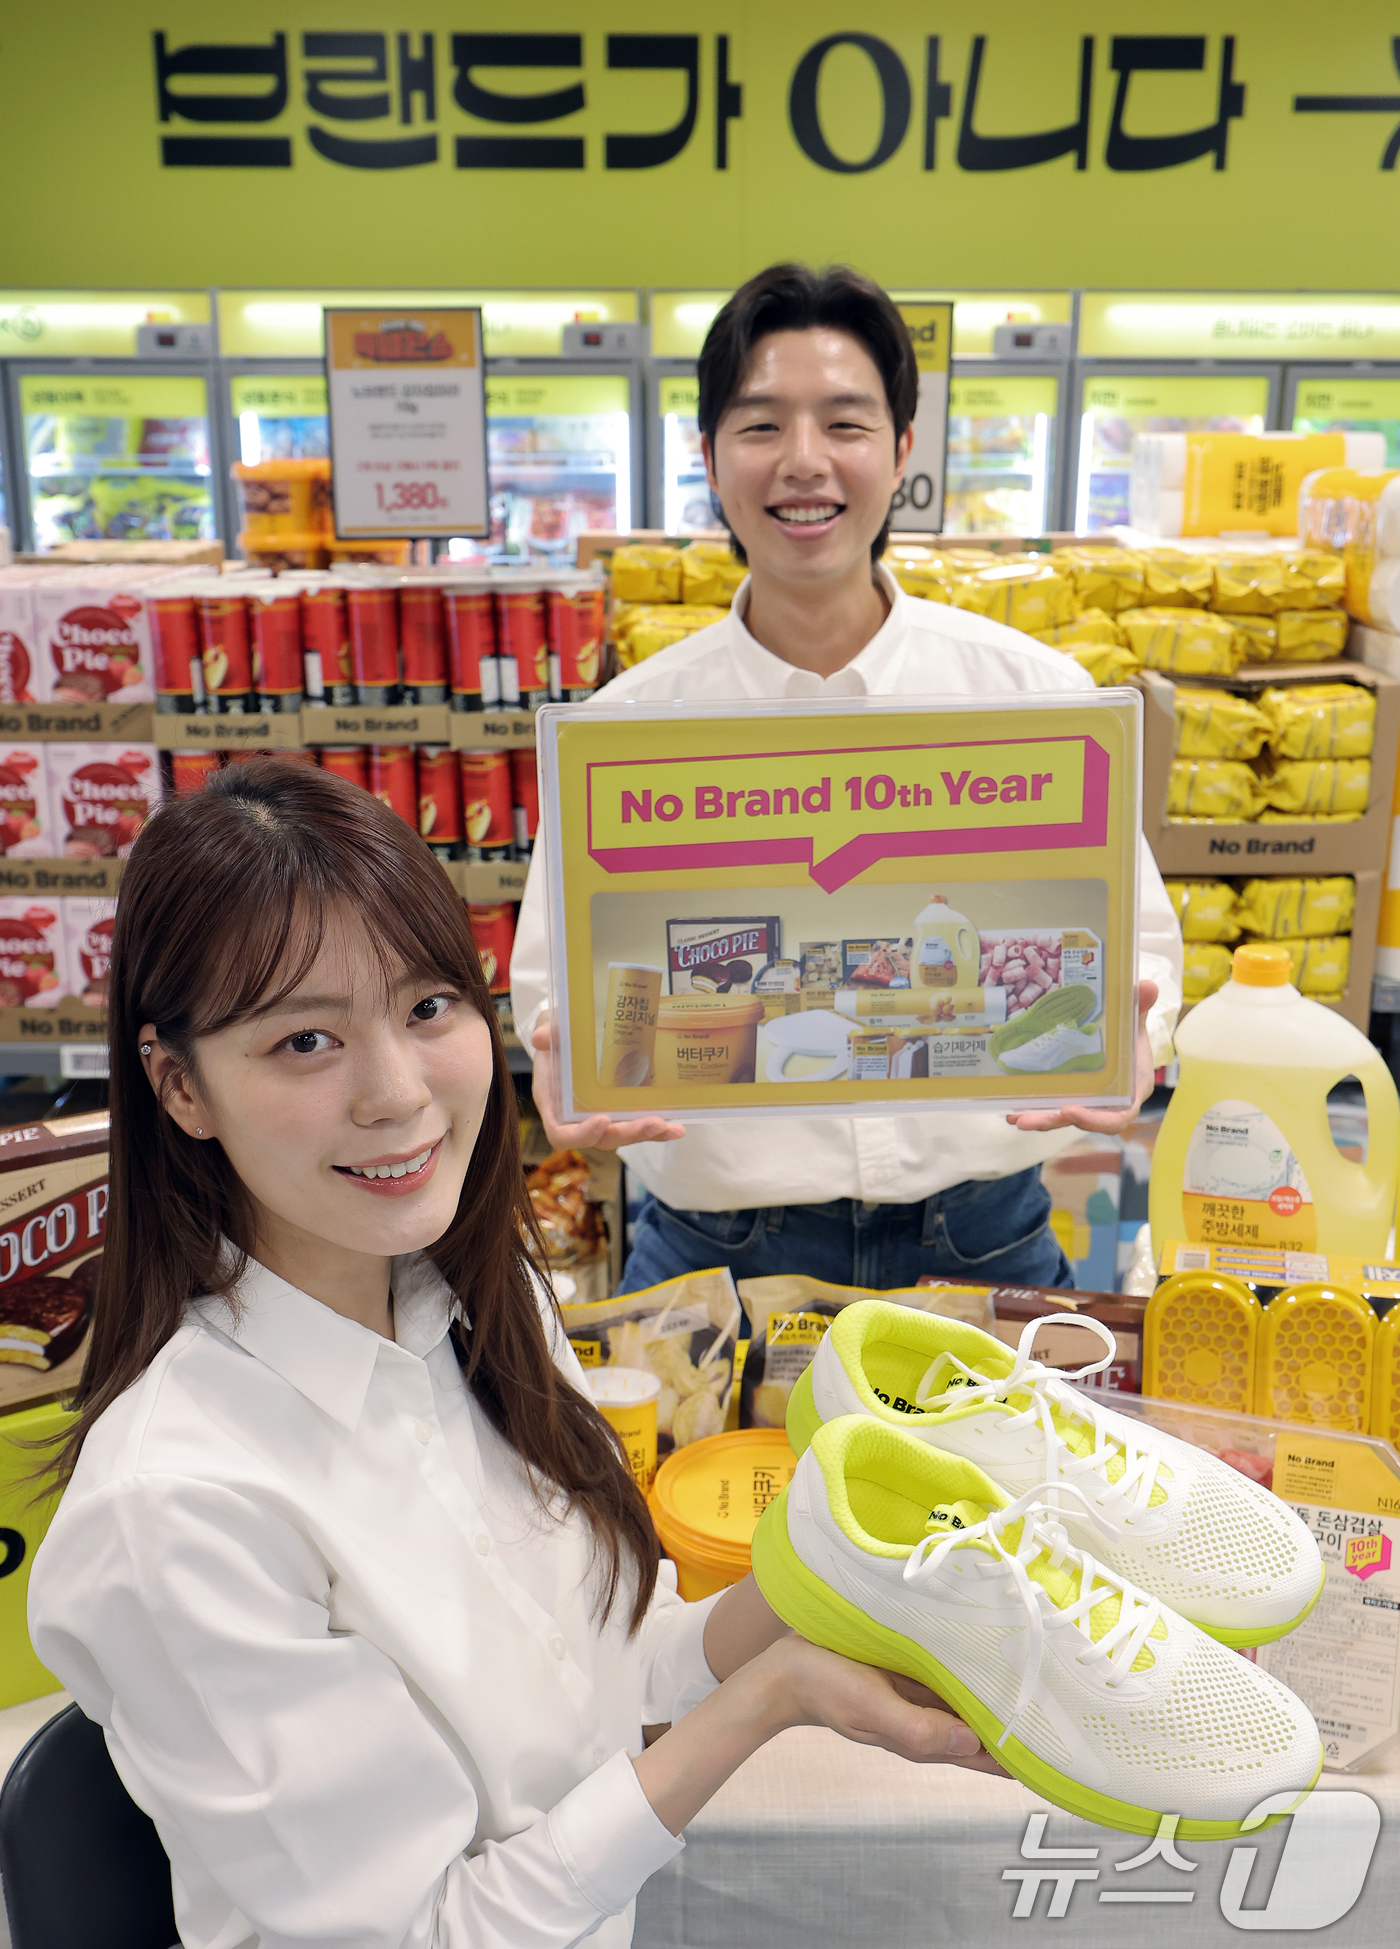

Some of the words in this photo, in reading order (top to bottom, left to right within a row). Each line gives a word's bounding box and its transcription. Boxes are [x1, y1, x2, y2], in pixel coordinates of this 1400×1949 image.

[152, 29, 744, 170] 브랜드가
[788, 31, 1246, 174] 아니다
[51, 620, 138, 648] Choco
[62, 647, 110, 673] Pie
[28, 714, 101, 732] Brand
[187, 723, 210, 737] No
[215, 722, 270, 737] Brand
[336, 718, 360, 731] No
[366, 717, 418, 731] Brand
[484, 723, 508, 736] No
[63, 777, 143, 802] Choco
[621, 790, 683, 823] No
[695, 777, 831, 820] Brand
[845, 774, 932, 812] 10th
[940, 769, 1053, 805] Year
[73, 802, 120, 826] Pie
[1208, 837, 1240, 855] No
[1246, 835, 1316, 855] Brand
[36, 870, 107, 888] Brand
[674, 938, 730, 968] CHOCO
[732, 931, 760, 954] PIE
[616, 995, 650, 1011] 감자칩
[614, 1010, 656, 1026] 오리지널
[20, 1019, 53, 1035] No
[677, 1046, 729, 1061] 버터쿠키
[933, 1040, 987, 1054] 습기제거제
[0, 1127, 40, 1146] PIE
[1220, 1126, 1249, 1135] Brand
[1202, 1203, 1245, 1220] 깨끗한
[1202, 1219, 1260, 1239] 주방세제
[773, 1318, 794, 1331] No
[1033, 1349, 1051, 1359] RT
[1287, 1454, 1301, 1463] No
[1304, 1457, 1335, 1468] Brand
[928, 1511, 948, 1521] No
[1317, 1510, 1384, 1536] 돈삼겹살
[1351, 1539, 1378, 1554] 10th
[1352, 1550, 1377, 1565] year
